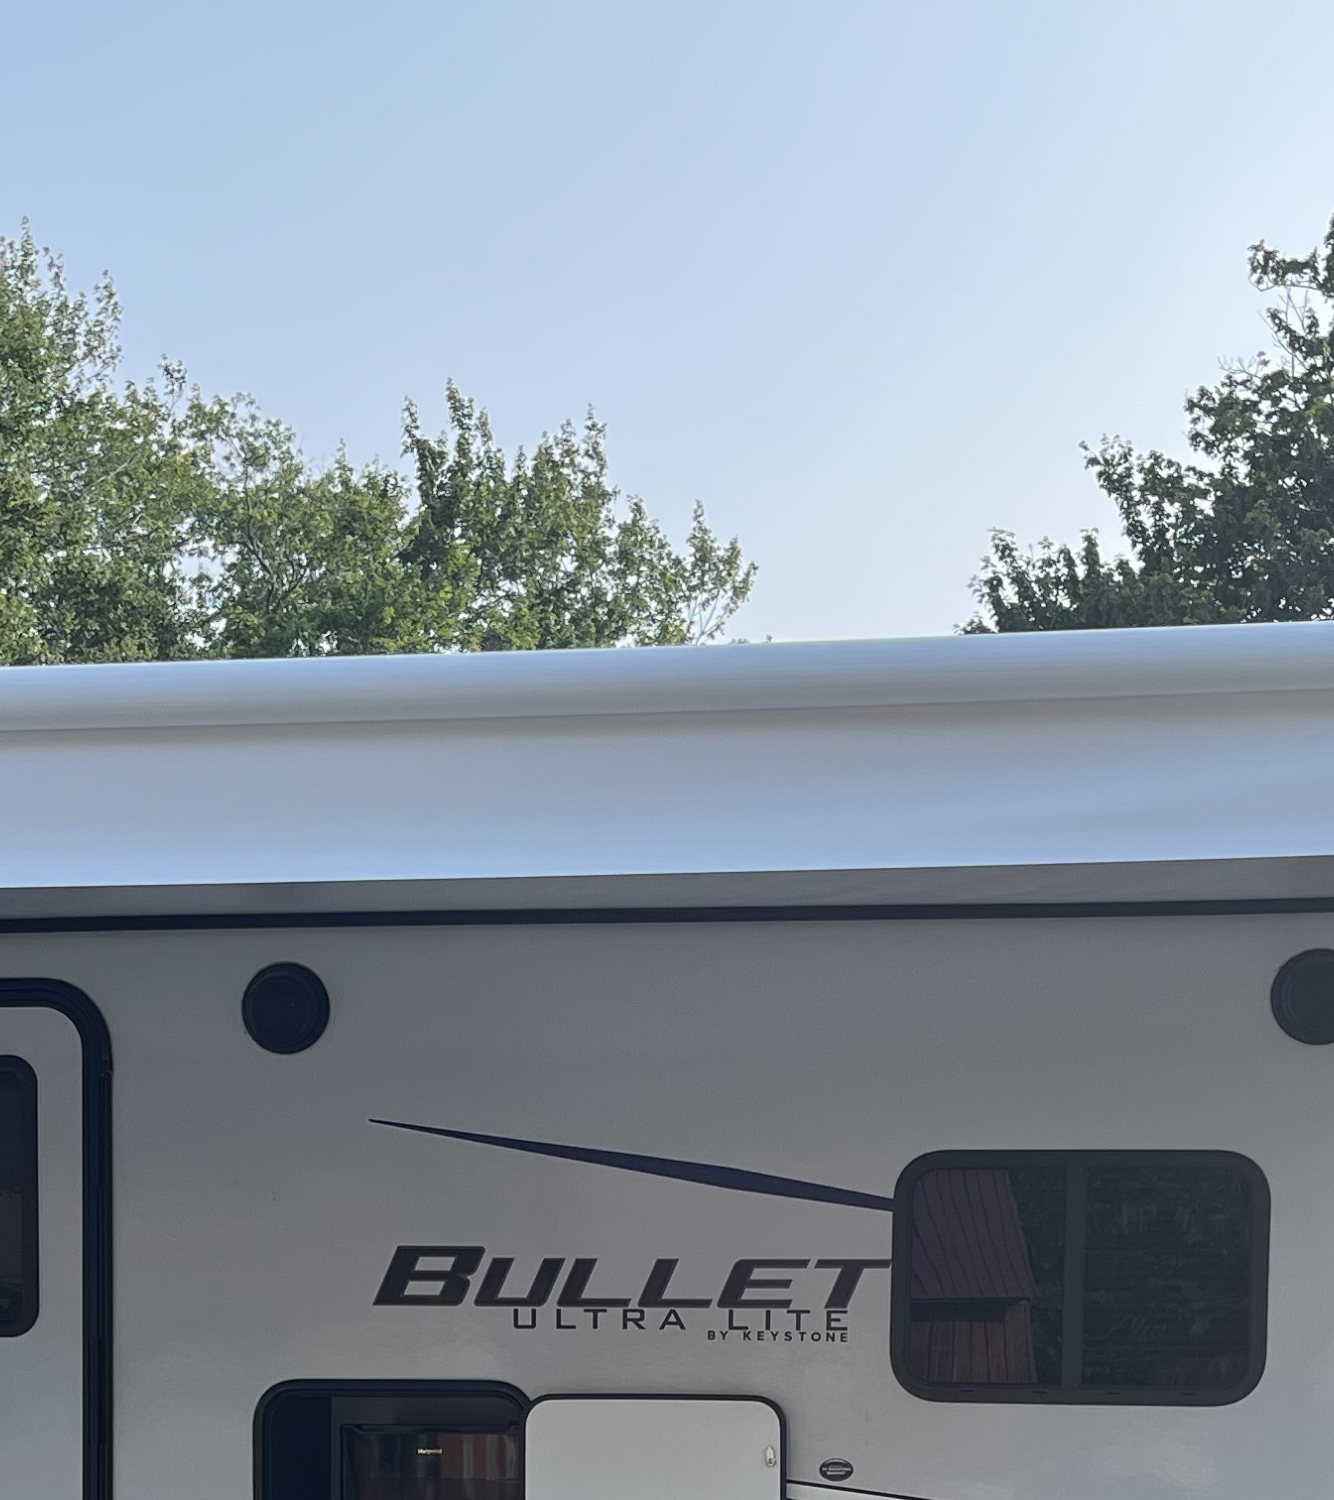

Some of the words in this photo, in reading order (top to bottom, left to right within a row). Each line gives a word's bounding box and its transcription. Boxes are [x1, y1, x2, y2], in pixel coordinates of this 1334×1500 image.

[372, 1245, 892, 1308] BULLET
[513, 1308, 686, 1330] ULTRA
[728, 1309, 848, 1331] LITE
[707, 1331, 729, 1341] BY
[742, 1332, 849, 1343] KEYSTONE
